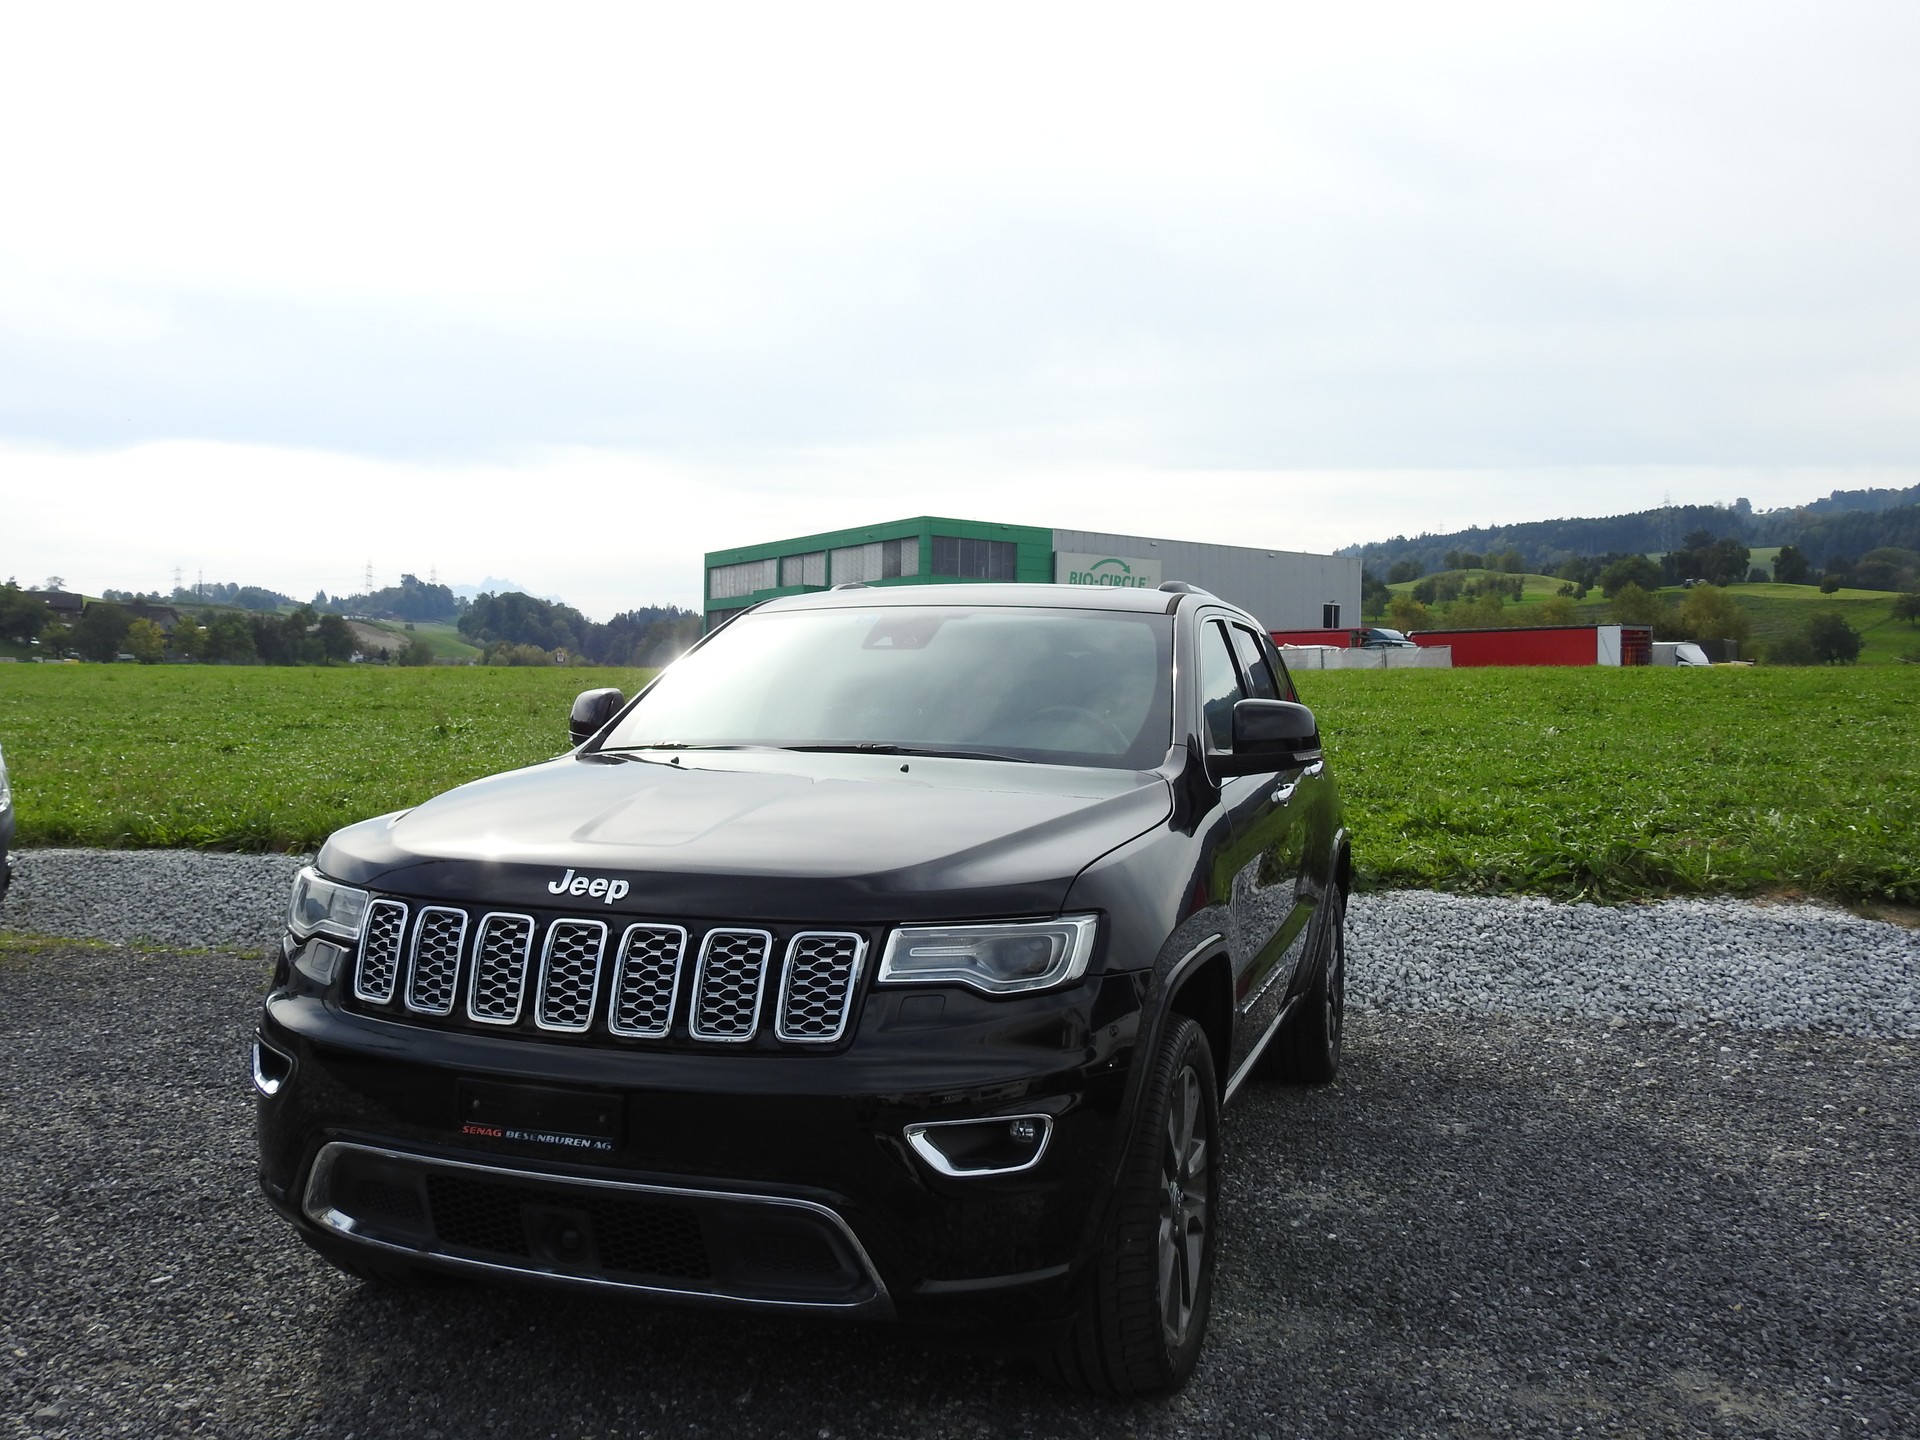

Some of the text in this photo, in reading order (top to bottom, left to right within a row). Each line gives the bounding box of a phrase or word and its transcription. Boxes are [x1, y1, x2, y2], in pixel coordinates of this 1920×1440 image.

[548, 869, 629, 904] Jeep
[462, 1125, 612, 1150] SENAG BESENBUREN AG
